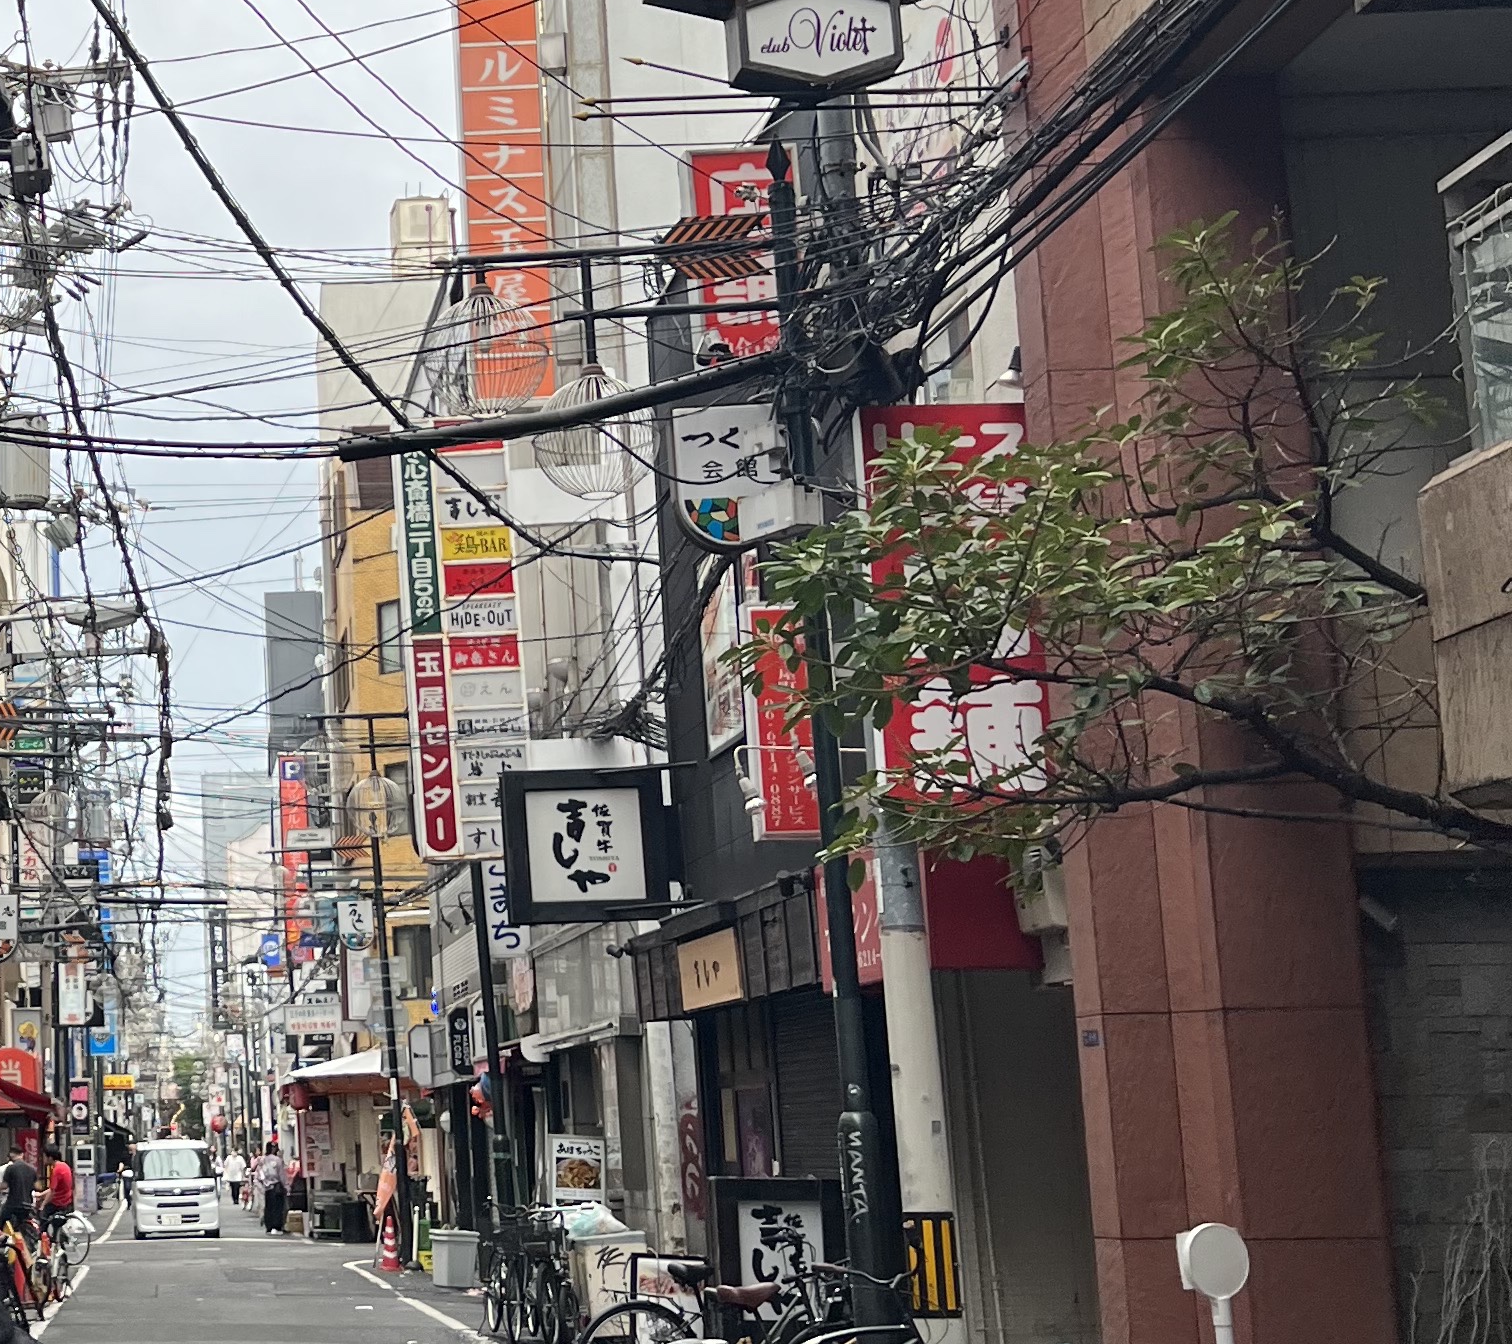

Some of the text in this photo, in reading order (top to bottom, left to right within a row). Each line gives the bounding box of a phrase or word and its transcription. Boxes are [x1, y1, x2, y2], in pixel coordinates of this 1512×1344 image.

[788, 7, 877, 58] Violet
[414, 650, 454, 842] 玉屋センター
